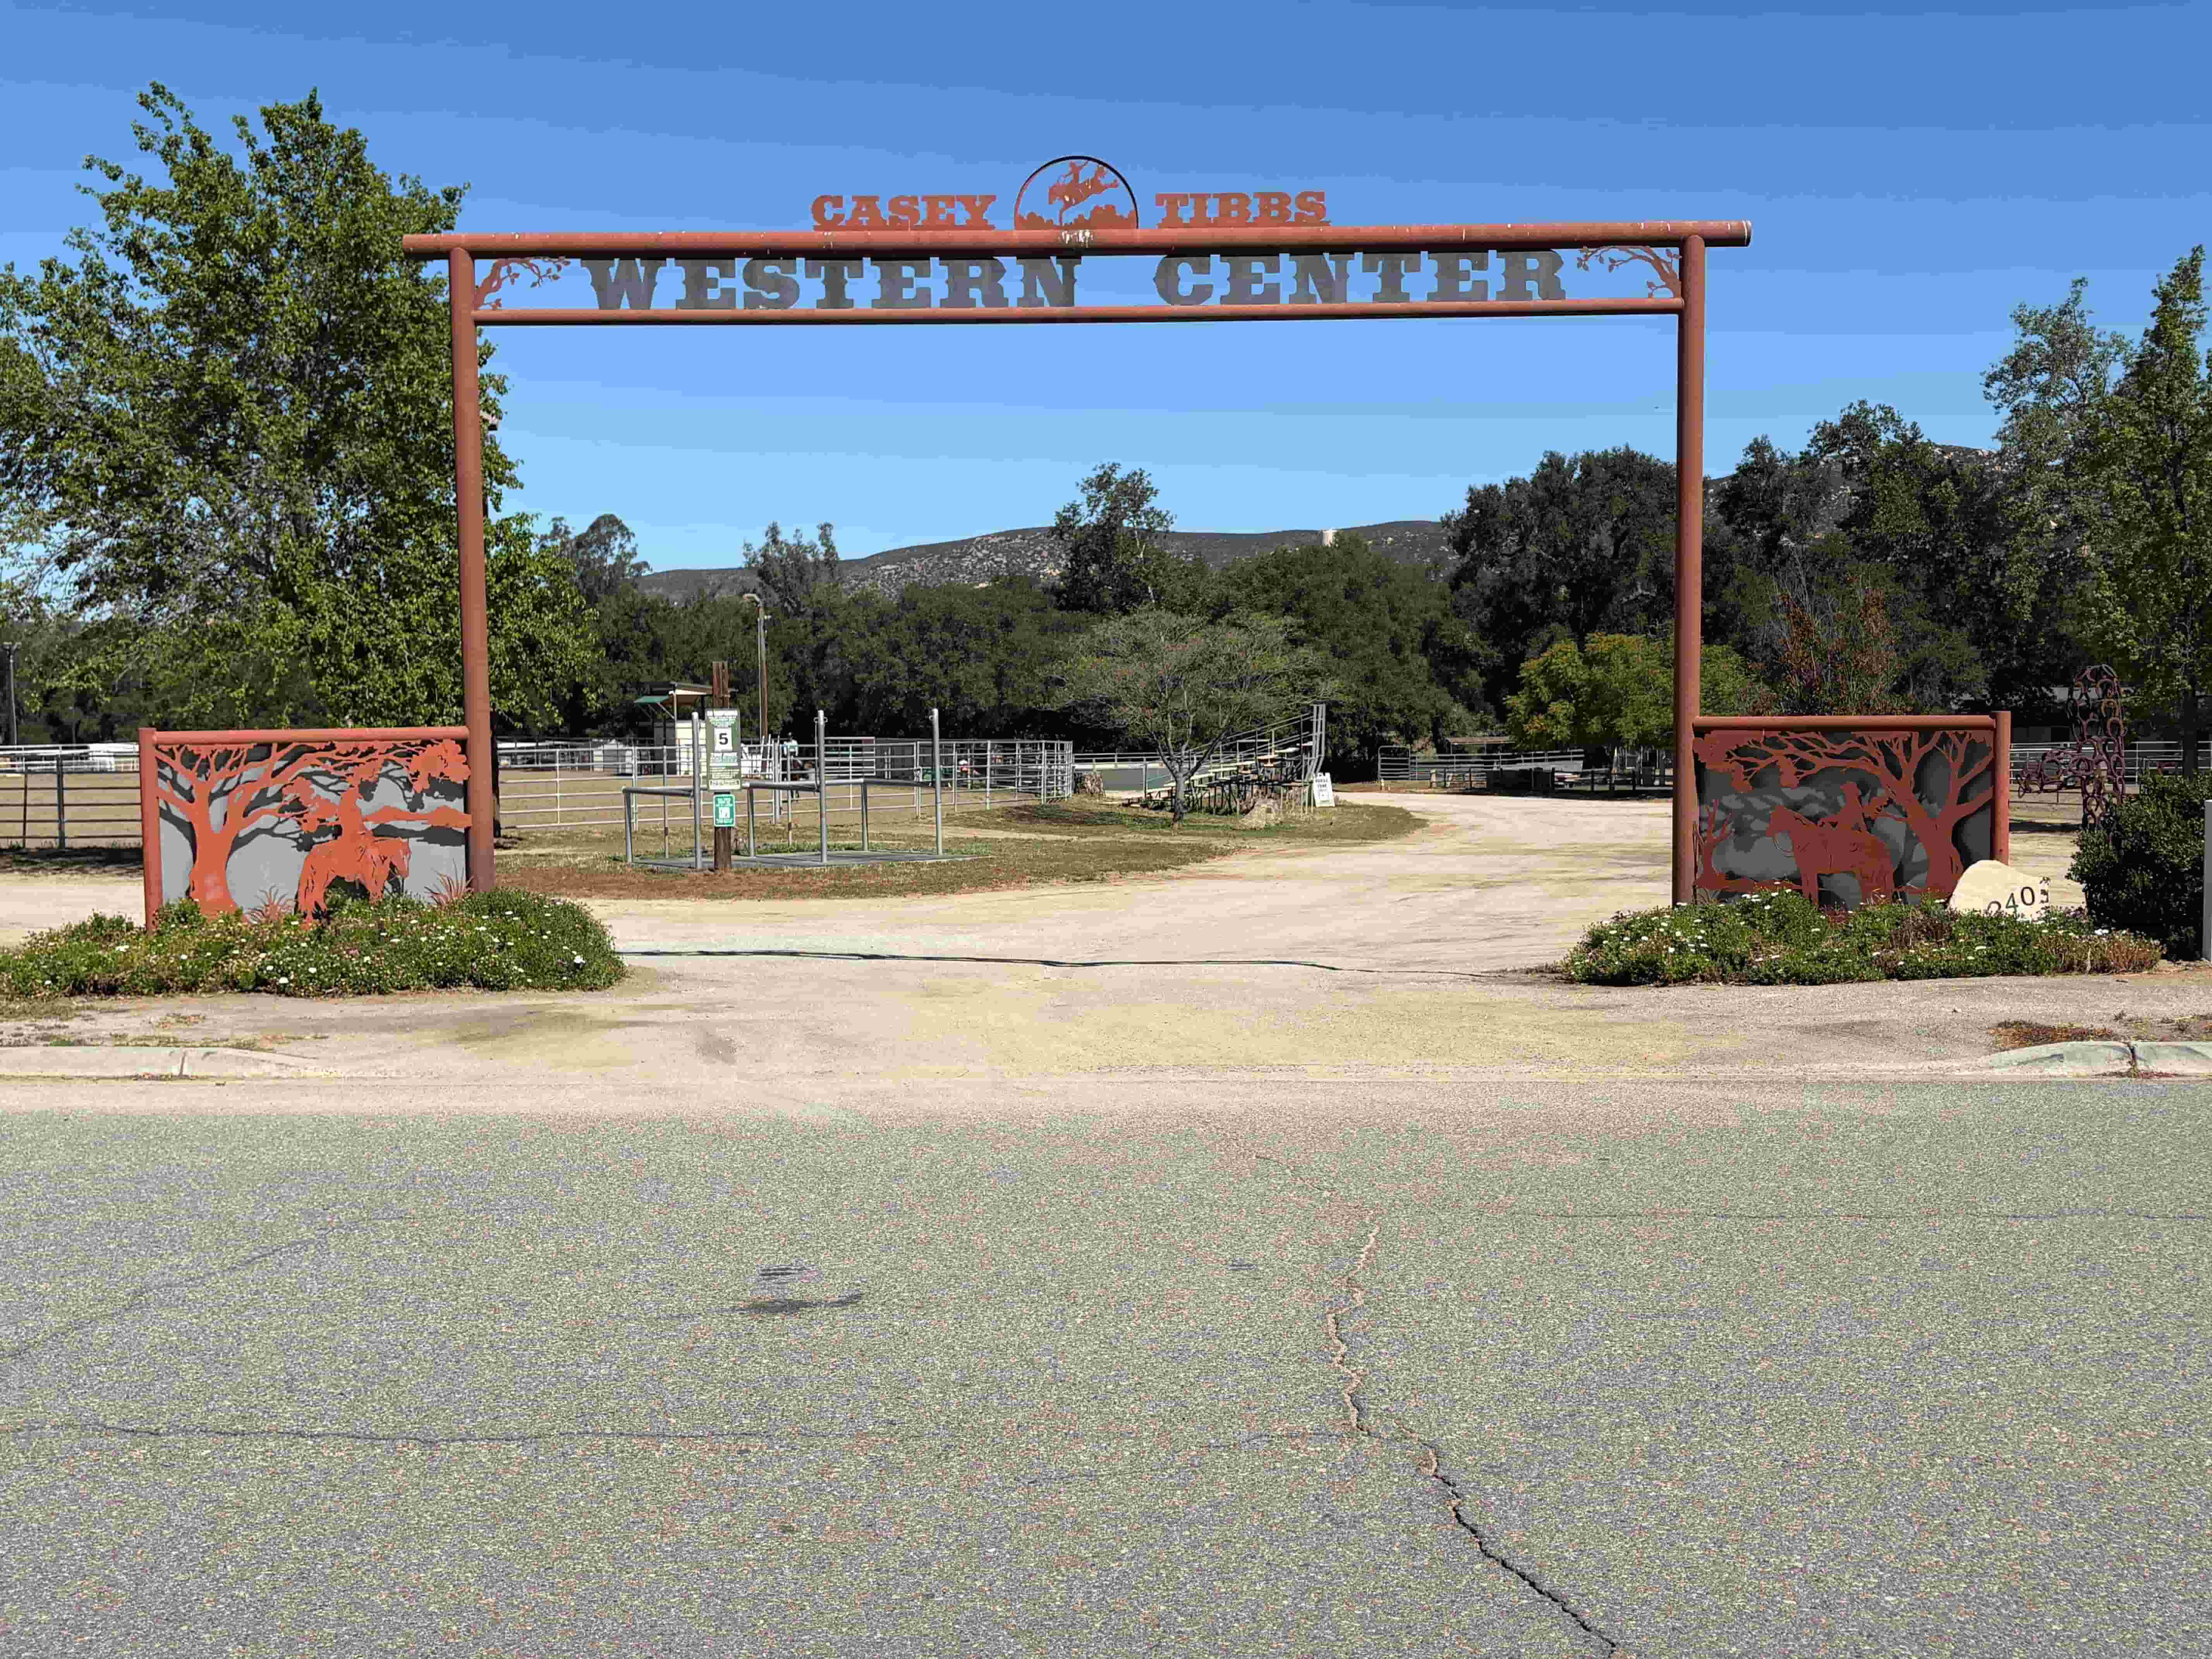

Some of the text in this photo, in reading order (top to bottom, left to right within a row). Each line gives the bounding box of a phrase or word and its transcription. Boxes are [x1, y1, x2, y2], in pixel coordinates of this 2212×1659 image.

[810, 191, 1330, 229] CASEY TIBBS
[581, 249, 1566, 310] WESTERN CENTER
[719, 733, 728, 745] 5
